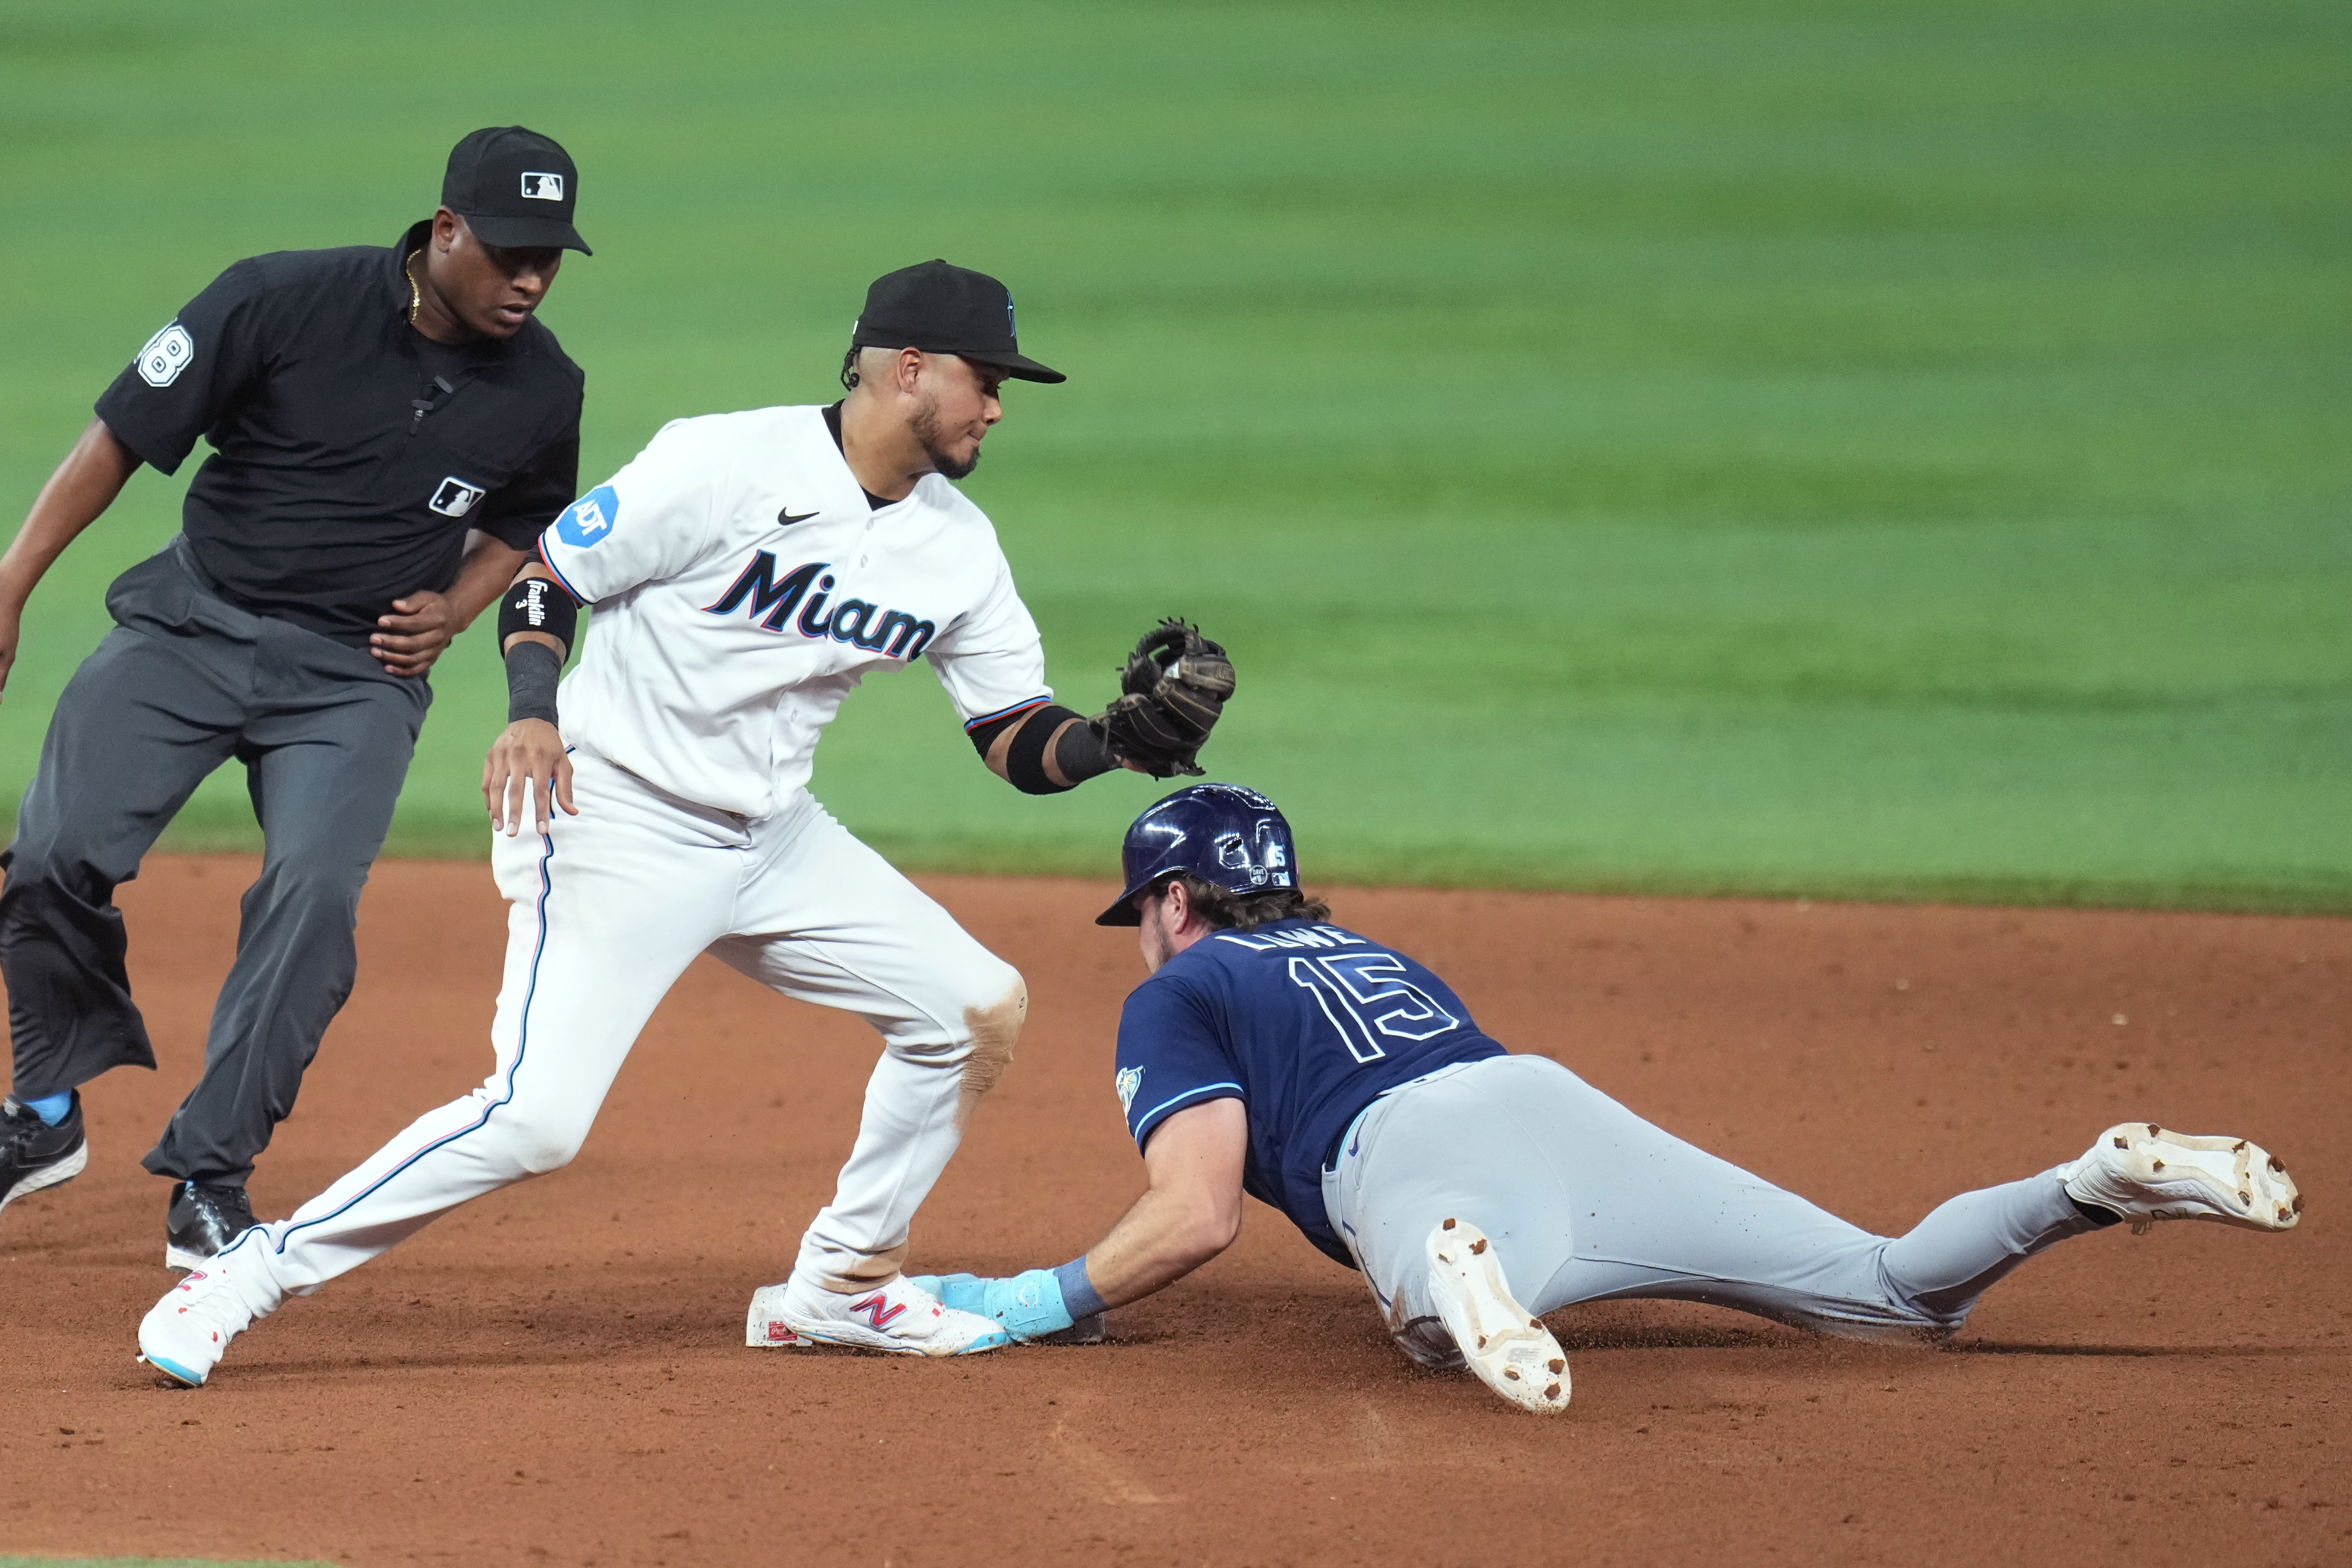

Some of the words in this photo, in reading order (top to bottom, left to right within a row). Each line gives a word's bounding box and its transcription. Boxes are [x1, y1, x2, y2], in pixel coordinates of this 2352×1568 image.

[573, 499, 607, 536] ADT
[515, 599, 528, 609] 3
[527, 580, 548, 626] Franklin
[700, 549, 936, 662] Miam
[1289, 953, 1459, 1064] 15
